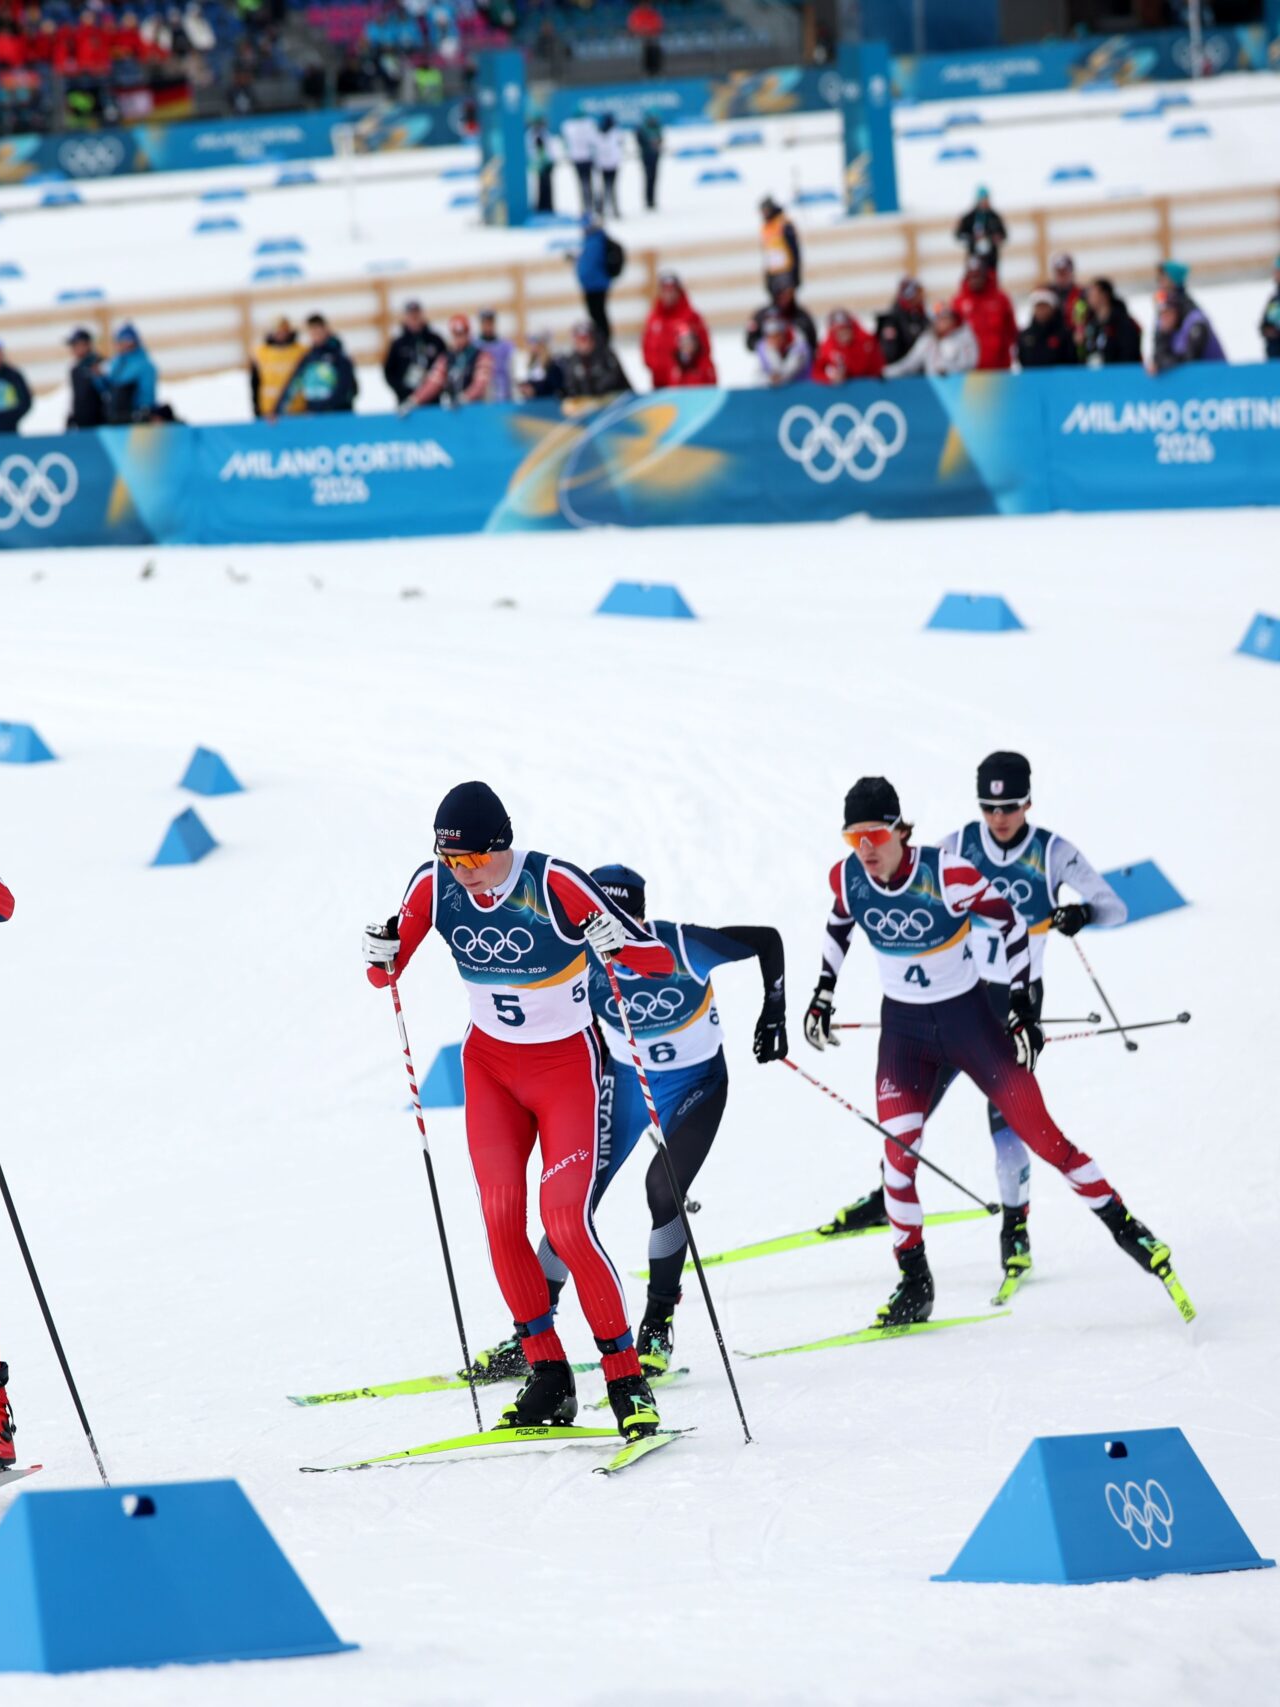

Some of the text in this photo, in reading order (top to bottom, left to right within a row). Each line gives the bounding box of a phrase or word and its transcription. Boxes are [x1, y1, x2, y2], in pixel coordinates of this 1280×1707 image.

[1182, 397, 1280, 431] CORTIN
[436, 828, 462, 838] NORGE
[601, 886, 629, 898] ONIA
[528, 966, 548, 974] 2026
[904, 964, 931, 988] 4
[572, 981, 586, 1003] 5
[491, 992, 526, 1027] 5
[709, 1007, 720, 1026] 6
[648, 1041, 677, 1064] 6
[597, 1075, 615, 1171] ESTONIA
[541, 1153, 578, 1184] CRAFT
[515, 1428, 549, 1436] FISCHER
